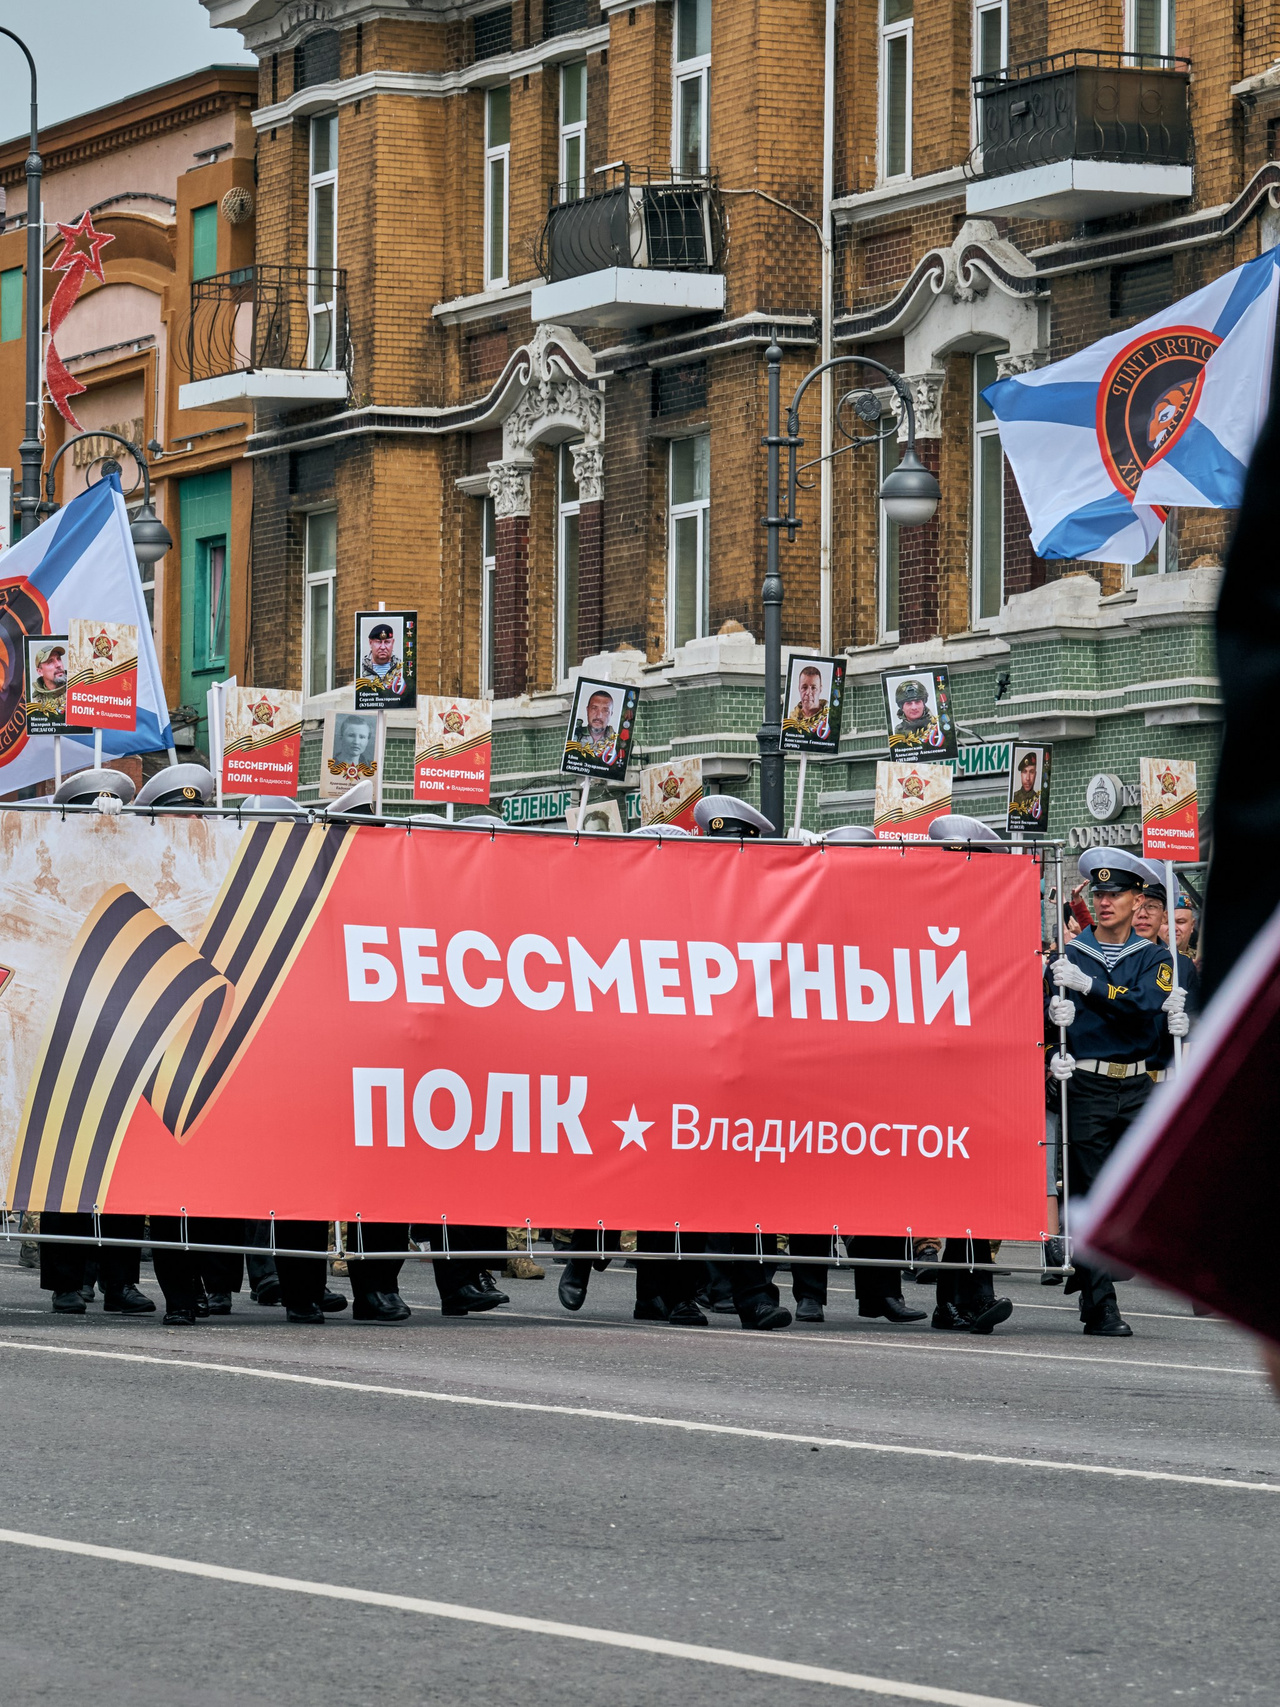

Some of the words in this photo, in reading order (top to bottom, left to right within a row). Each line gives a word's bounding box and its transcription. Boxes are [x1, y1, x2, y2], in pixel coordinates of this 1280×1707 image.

[72, 692, 132, 707] БЕССМЕРТНЫЙ
[71, 705, 95, 716] ПОЛК
[100, 710, 132, 719] Владивосток
[228, 759, 293, 773] БЕССМЕРТНЫЙ
[227, 773, 253, 783] ПОЛК
[259, 776, 292, 785] Владивосток
[420, 767, 485, 781] БЕССМЕРТНЫЙ
[420, 781, 445, 791] ПОЛК
[451, 784, 485, 793] Владивосток
[1147, 827, 1195, 839] БЕССМЕРТНЫЙ
[1147, 840, 1166, 850] ПОЛК
[343, 923, 972, 1027] БЕССМЕРТНЫЙ
[351, 1066, 593, 1156] ПОЛК
[671, 1103, 970, 1164] Владивосток
